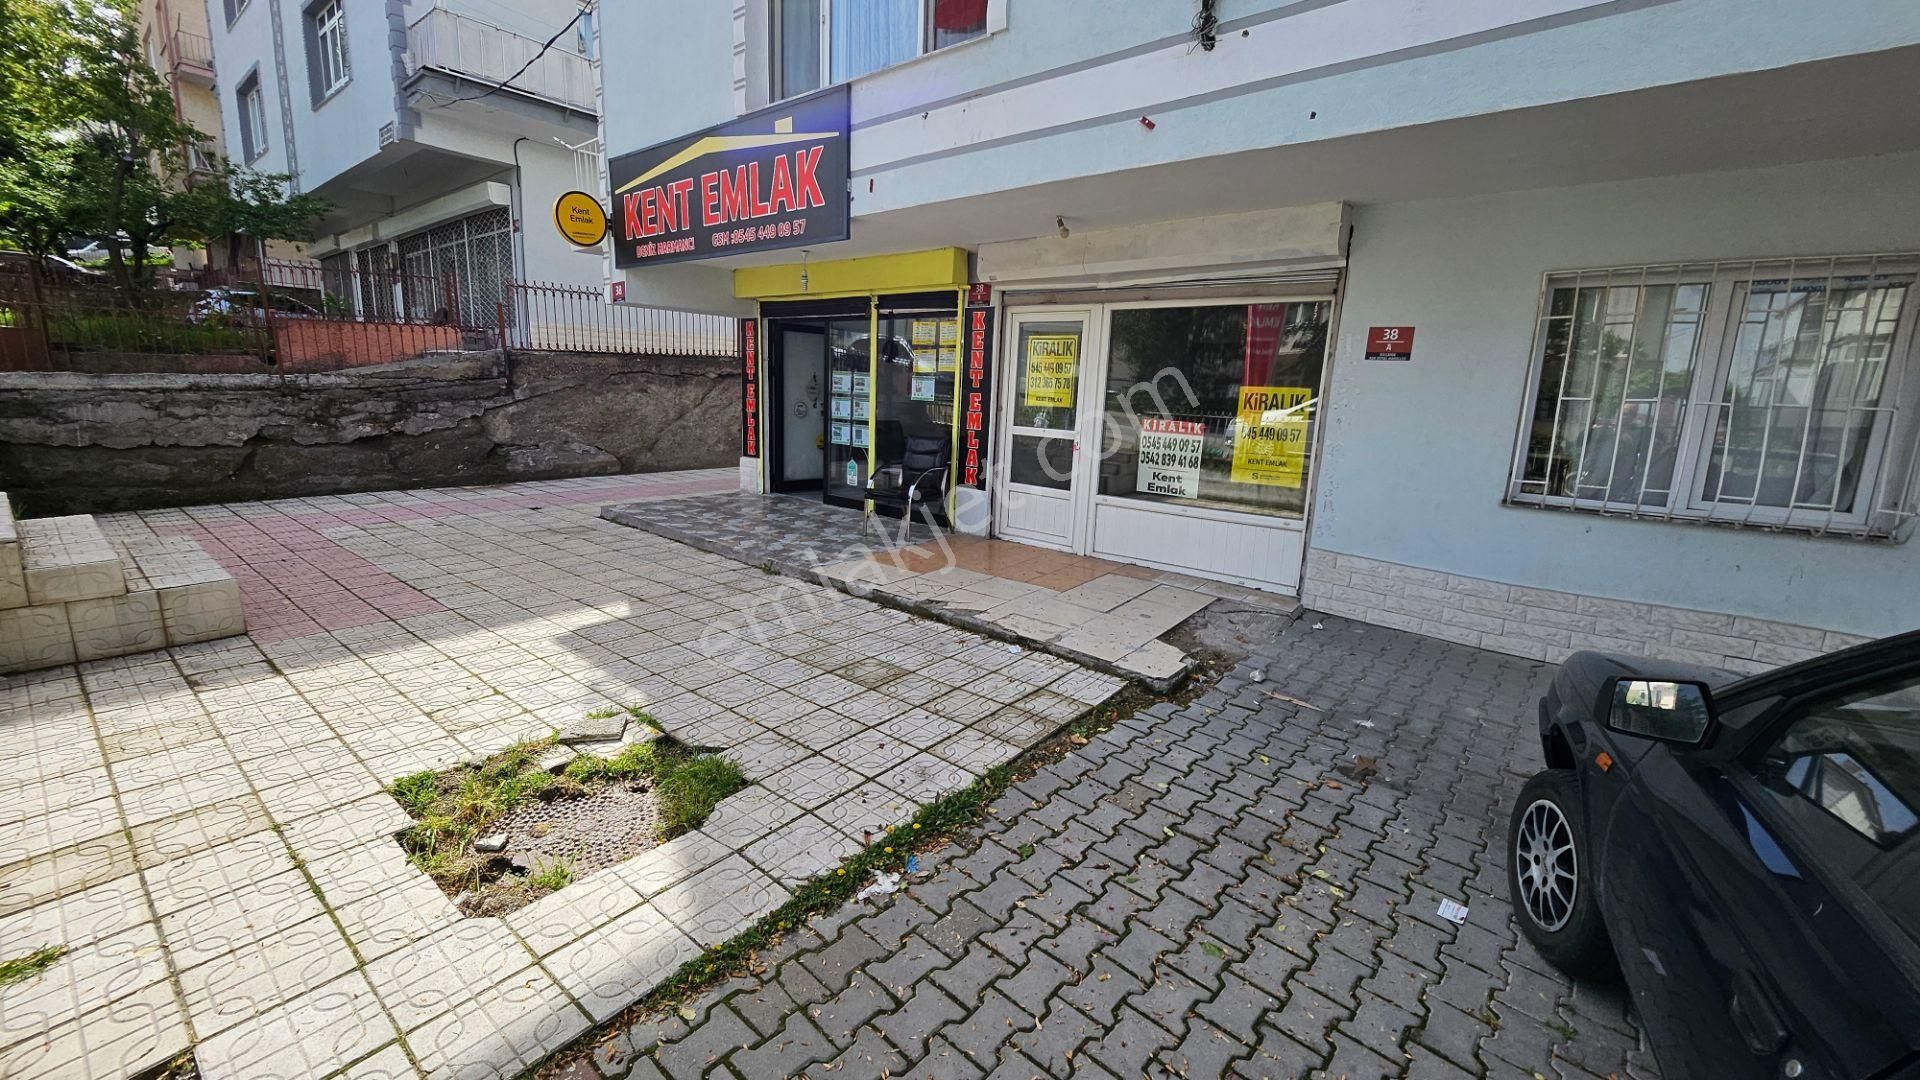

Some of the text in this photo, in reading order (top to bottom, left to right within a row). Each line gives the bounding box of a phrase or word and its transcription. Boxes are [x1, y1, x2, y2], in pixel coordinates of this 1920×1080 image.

[623, 145, 826, 241] KENT EMLAK
[571, 206, 590, 216] Kent
[570, 214, 592, 224] Emlak
[711, 231, 730, 248] GSM
[757, 223, 776, 240] 449
[777, 221, 791, 238] 09
[792, 218, 807, 235] 57
[976, 284, 984, 293] 38
[1383, 328, 1399, 341] 38
[969, 311, 986, 388] KENT
[1385, 343, 1392, 351] A
[1055, 362, 1063, 374] 09
[1064, 362, 1072, 374] 57
[745, 321, 756, 455] KENT EMLAK
[1030, 377, 1042, 388] 312
[1054, 377, 1062, 389] 75
[964, 393, 982, 486] EMLAK
[1259, 426, 1275, 441] 449
[1276, 428, 1288, 441] 09
[1289, 429, 1302, 443] 57
[1141, 435, 1202, 454] 0545 449 09 57
[1161, 452, 1177, 467] 839
[1177, 454, 1187, 468] 41
[1188, 456, 1199, 469] 68
[1247, 458, 1288, 468] KENT EMLAK
[1152, 471, 1183, 484] Kent
[1147, 482, 1186, 496] Emlak
